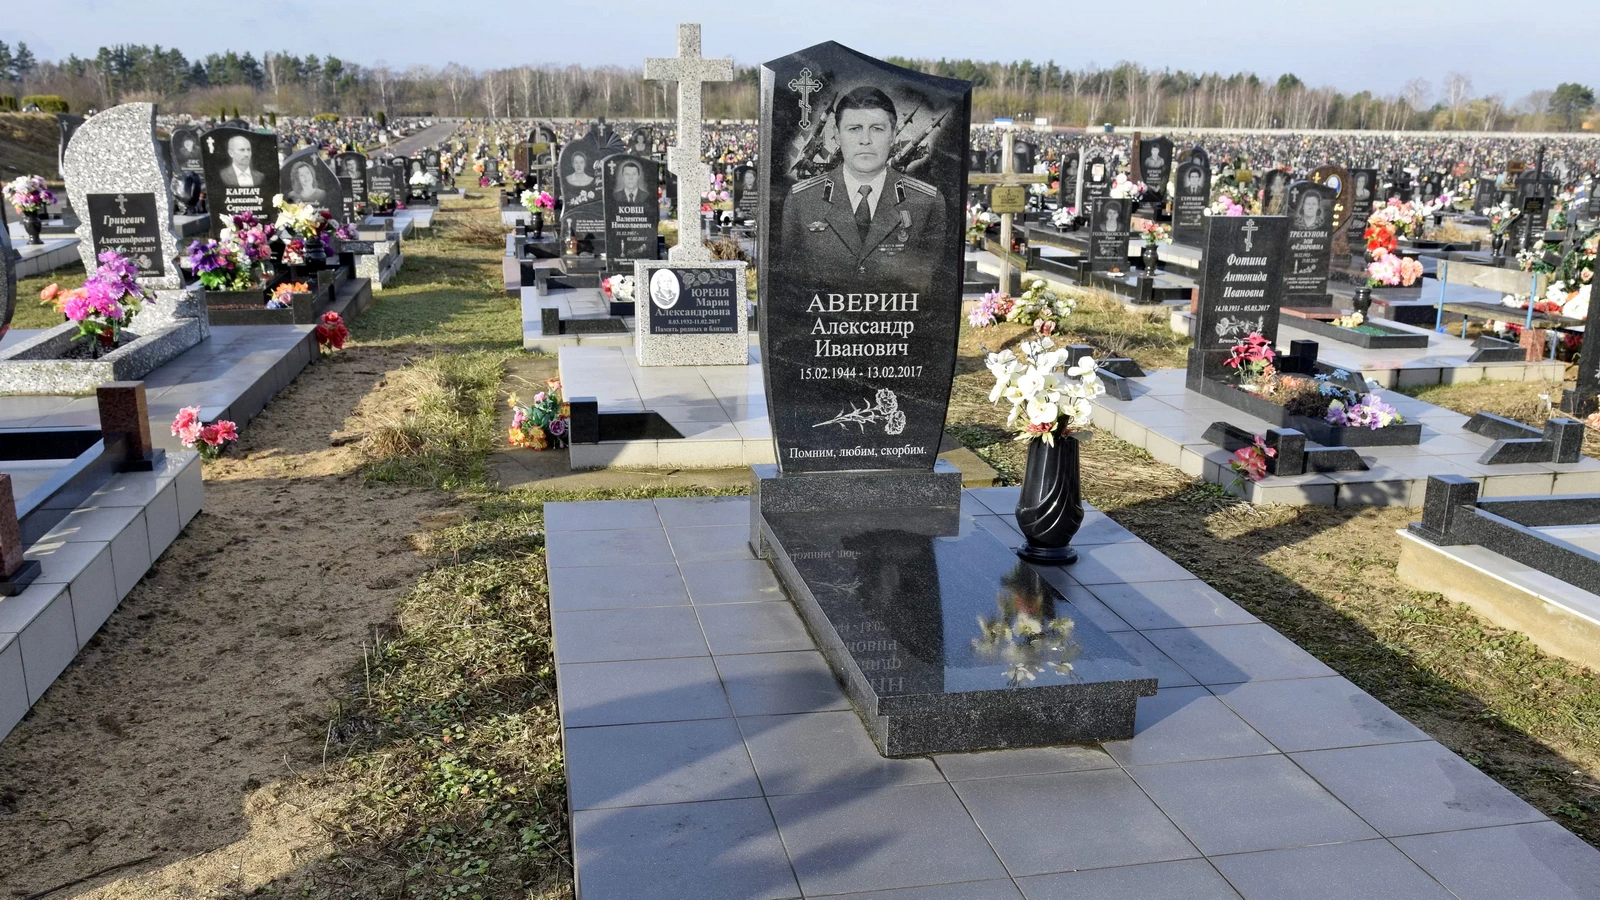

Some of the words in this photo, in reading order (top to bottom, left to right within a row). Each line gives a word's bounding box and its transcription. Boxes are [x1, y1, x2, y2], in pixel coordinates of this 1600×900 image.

[224, 196, 264, 204] Александр
[226, 204, 262, 213] Сергеевич
[103, 214, 146, 227] Грицевич
[116, 226, 136, 234] Иван
[98, 236, 156, 245] Александрович
[1227, 254, 1268, 266] Фотина
[1222, 270, 1268, 282] Антонида
[692, 288, 729, 297] ЮРЕНЯ
[1223, 287, 1264, 298] Ивановна
[696, 298, 730, 308] Мария
[806, 293, 919, 312] АВЕРИН
[655, 308, 730, 317] Александровна
[811, 317, 914, 338] Александр
[814, 340, 908, 357] Иванович
[800, 367, 856, 380] 15.02.1944
[867, 366, 922, 378] 13.02.2017
[790, 447, 836, 458] Помним,
[838, 446, 878, 458] любим,
[880, 444, 927, 458] скорбим.
